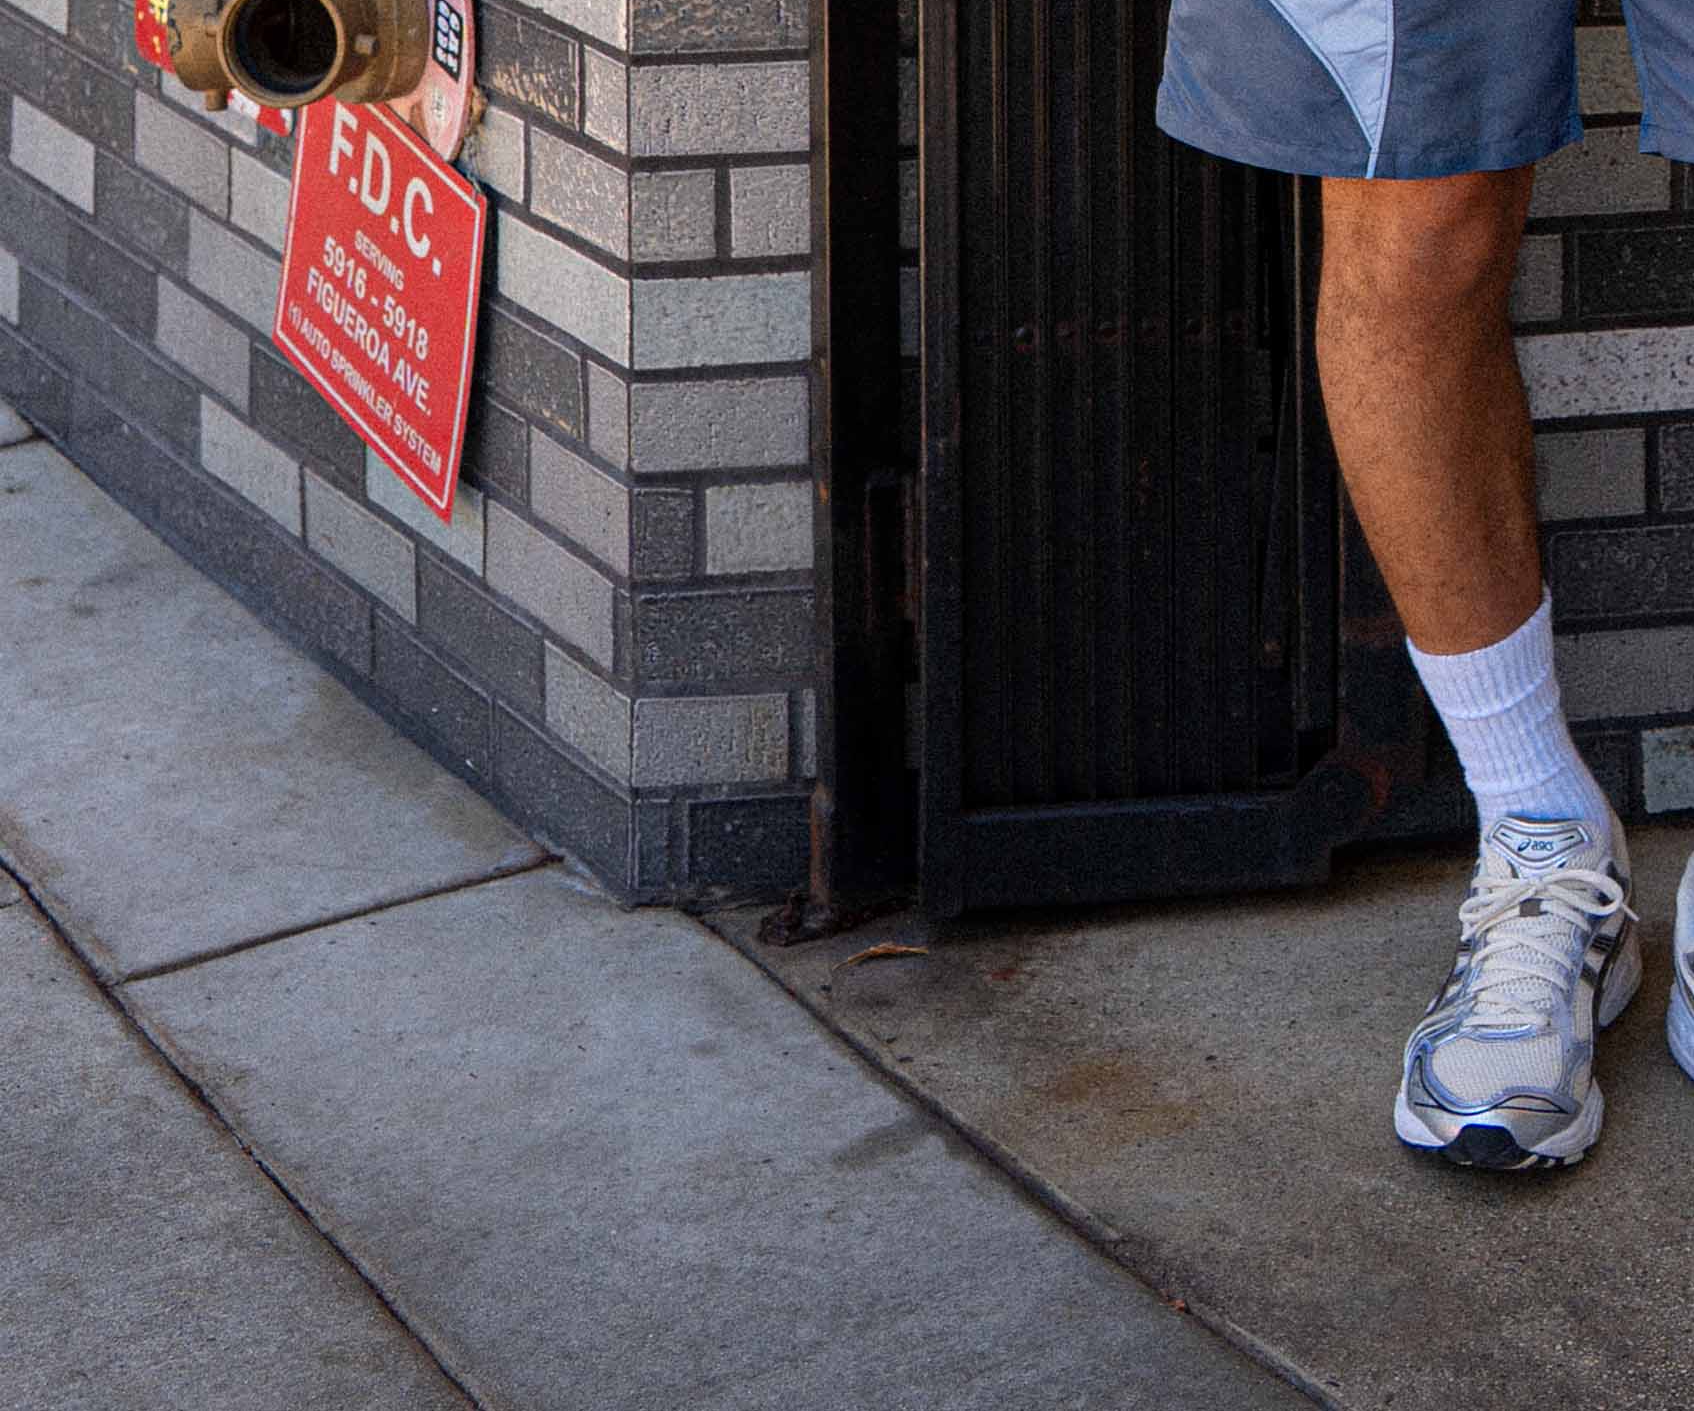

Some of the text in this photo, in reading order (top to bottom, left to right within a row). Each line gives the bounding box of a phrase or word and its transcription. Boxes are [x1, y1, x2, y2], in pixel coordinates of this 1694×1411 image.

[328, 98, 442, 277] F.D.C.
[354, 230, 405, 291] SERVING
[307, 267, 433, 416] FIGUEROA AVE.
[323, 235, 429, 361] 5916 5918
[300, 317, 442, 476] AUTO SPRINKLER SYSTEM
